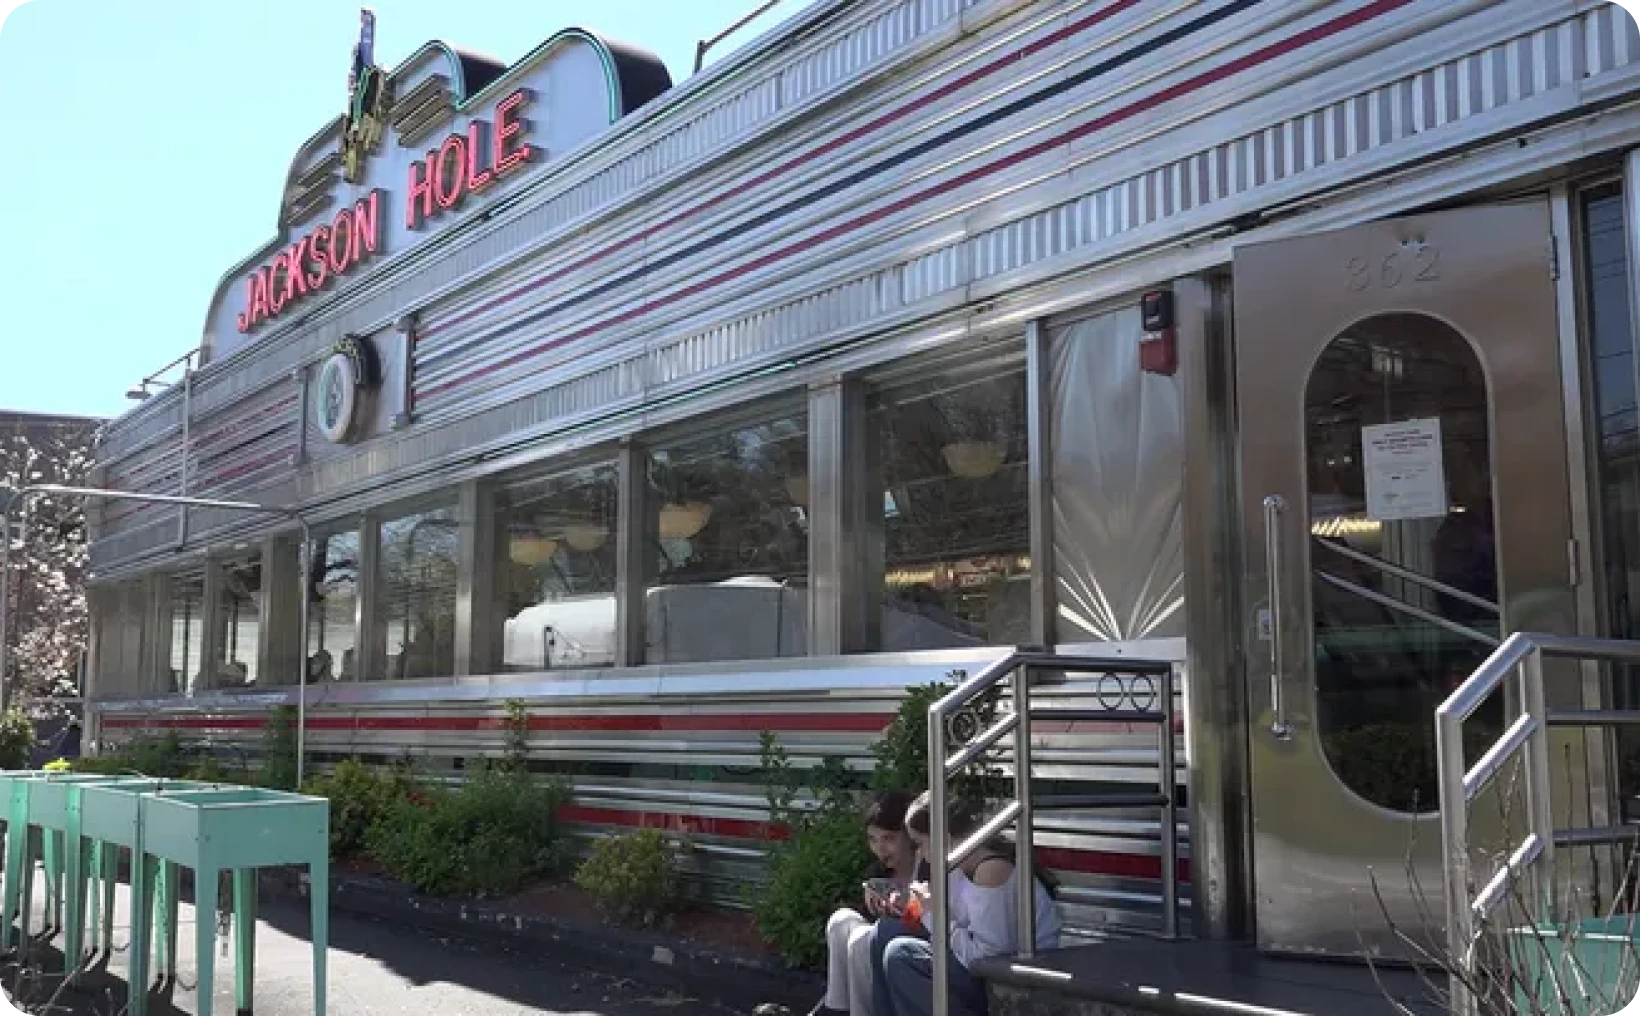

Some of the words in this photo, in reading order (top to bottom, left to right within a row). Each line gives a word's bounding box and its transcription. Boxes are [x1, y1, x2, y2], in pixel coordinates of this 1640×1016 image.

[236, 187, 381, 334] JACKSON
[405, 87, 534, 231] HOLE
[1345, 245, 1441, 292] 362
